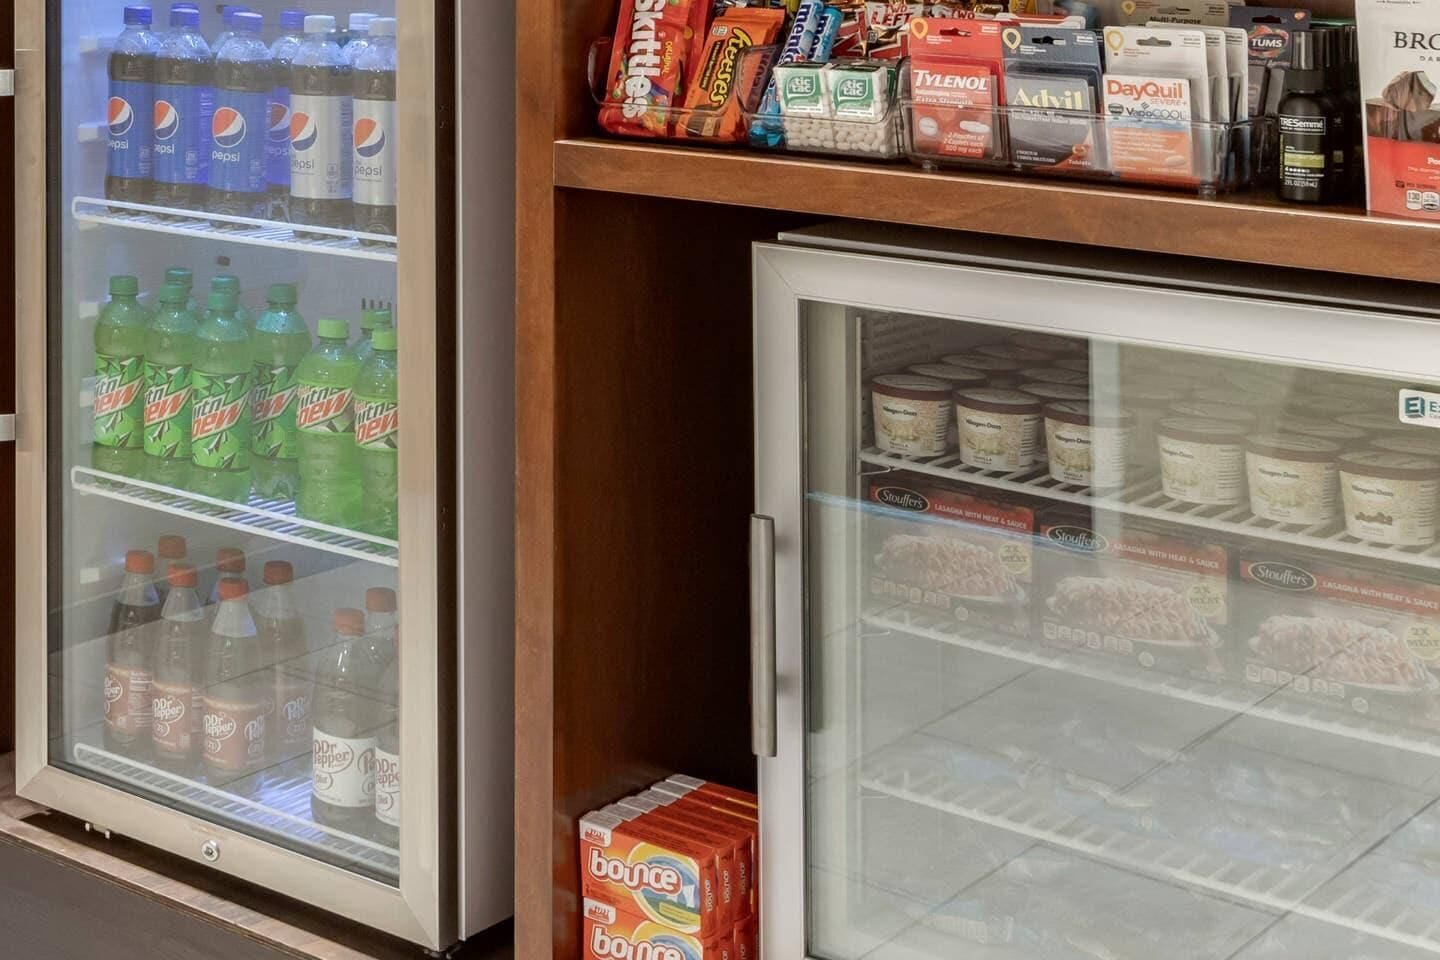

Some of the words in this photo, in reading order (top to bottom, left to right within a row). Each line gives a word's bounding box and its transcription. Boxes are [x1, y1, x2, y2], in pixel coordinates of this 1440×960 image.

[1149, 16, 1202, 25] Multi-Purpose
[1251, 37, 1283, 48] TUMS
[794, 76, 811, 86] tic
[847, 79, 864, 89] tic
[913, 69, 989, 90] TYLENOL
[792, 85, 811, 93] tac
[843, 88, 864, 96] tac
[1106, 79, 1184, 101] DayQuil
[1012, 87, 1083, 111] Advil
[212, 150, 240, 162] pepsi
[355, 164, 382, 177] pepsi
[881, 489, 924, 509] Stouffer's
[964, 509, 982, 520] WITH
[982, 513, 1000, 524] MEAT
[1006, 519, 1028, 530] SAUCE
[1055, 528, 1101, 549] Stouffer's
[1148, 548, 1167, 559] WITH
[1168, 552, 1188, 563] MEAT
[1195, 557, 1219, 569] SAUCE
[1257, 566, 1308, 586] Stouffer's
[1360, 587, 1382, 598] WITH
[1383, 591, 1405, 603] MEAT
[1413, 597, 1439, 610] SAUCE
[153, 699, 182, 721] Pepper
[159, 697, 173, 710] Dr
[204, 715, 233, 737] Pepper
[211, 714, 223, 726] Dr
[321, 740, 337, 753] Dr
[381, 758, 397, 773] Dr
[591, 849, 678, 891] bounce
